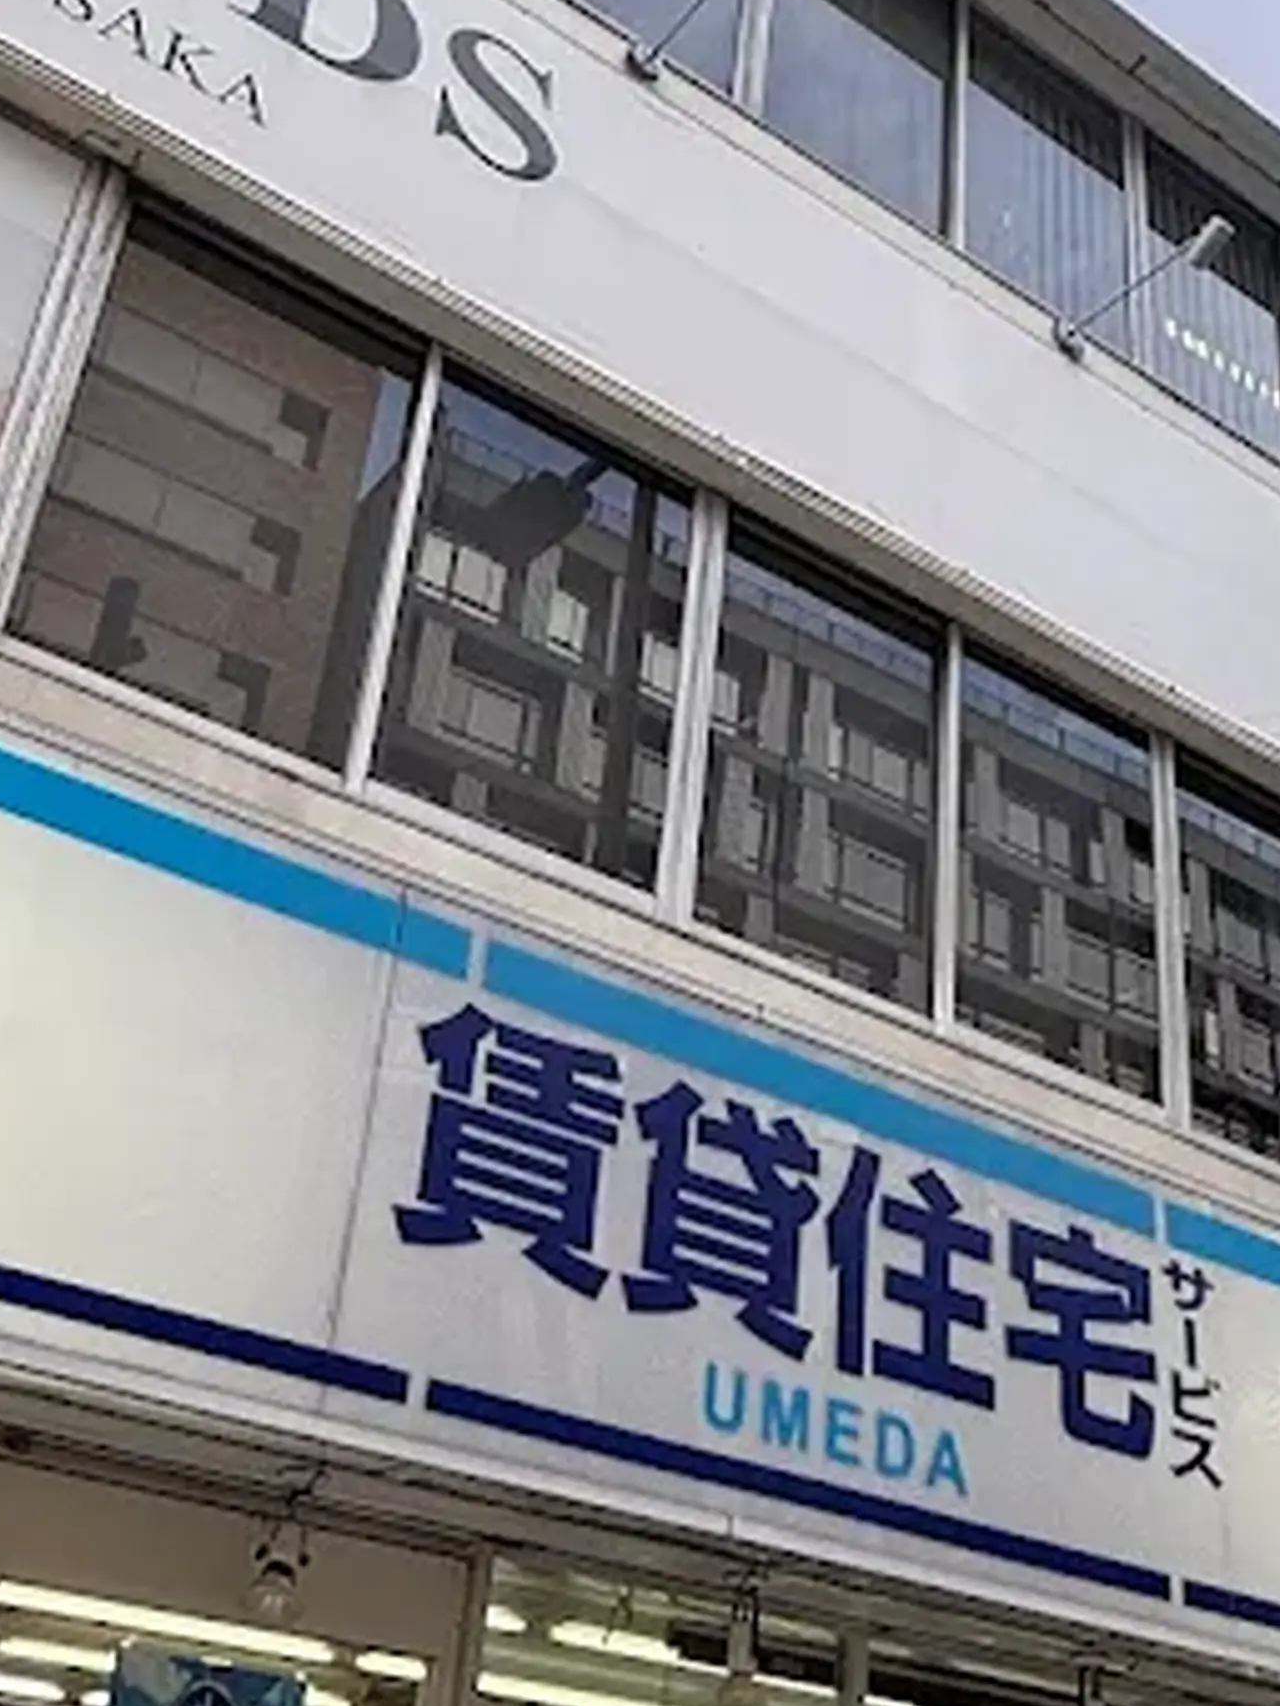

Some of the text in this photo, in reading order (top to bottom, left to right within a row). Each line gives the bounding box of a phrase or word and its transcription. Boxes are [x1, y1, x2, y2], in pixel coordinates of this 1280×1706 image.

[392, 1003, 1160, 1461] 賃貸住宅
[700, 1363, 970, 1495] UMEDA
[1162, 1261, 1223, 1490] サービス
